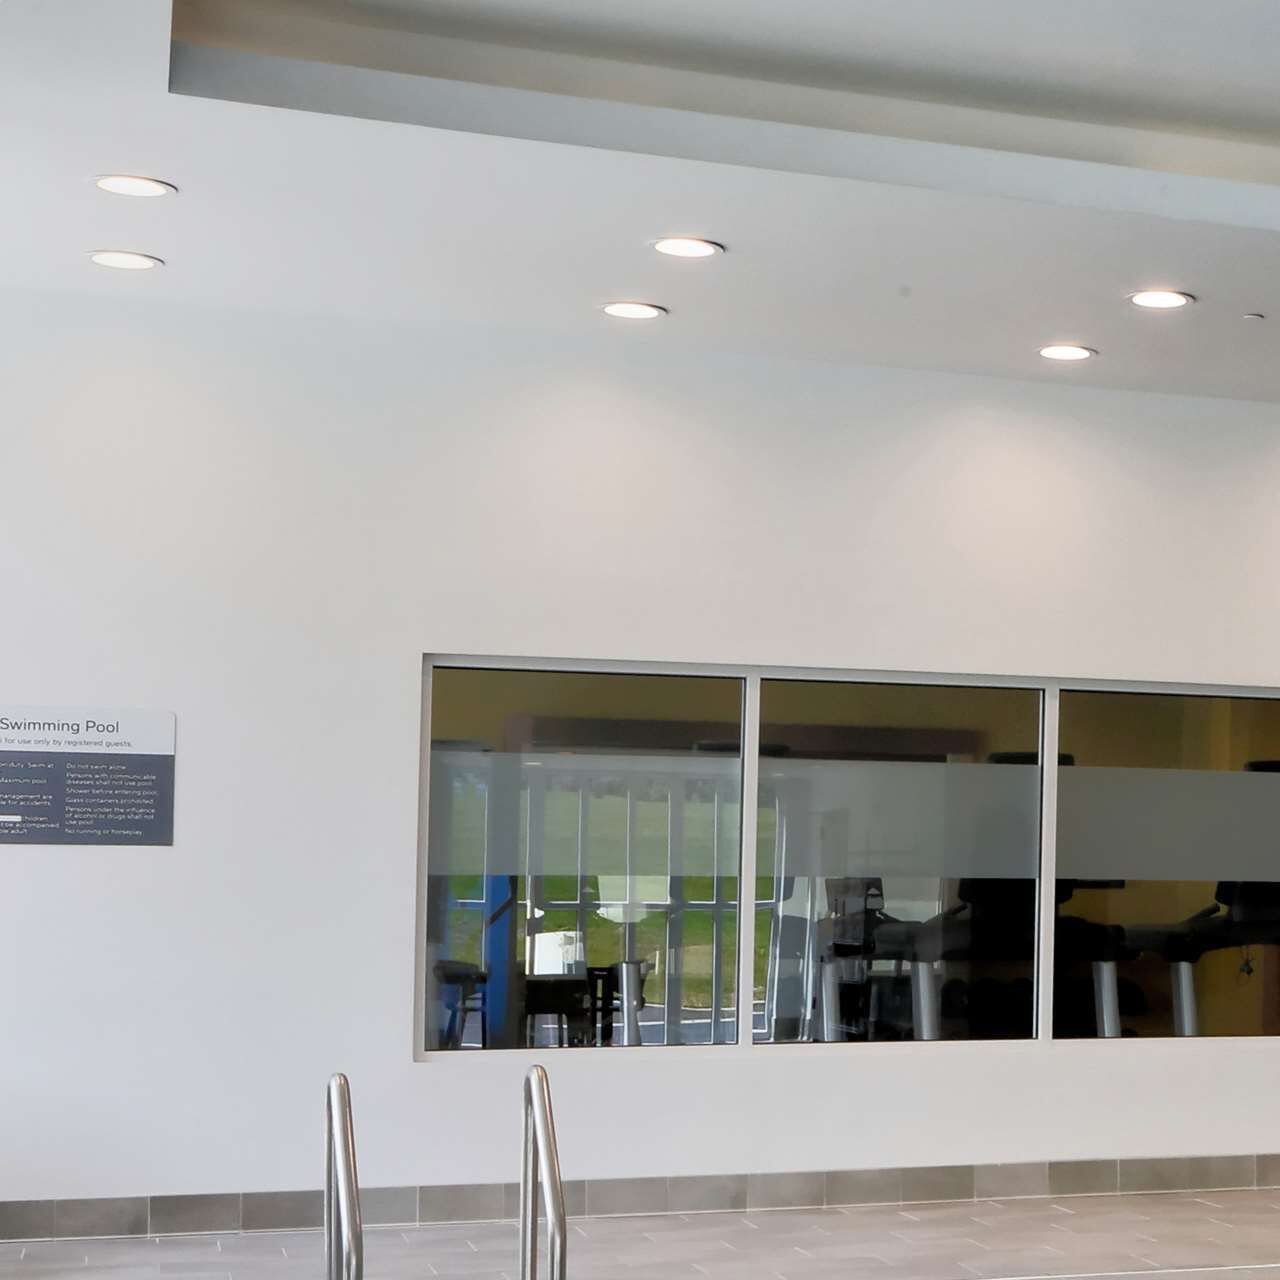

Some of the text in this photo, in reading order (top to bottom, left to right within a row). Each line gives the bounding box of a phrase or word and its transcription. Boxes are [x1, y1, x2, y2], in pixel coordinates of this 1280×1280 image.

[0, 717, 119, 735] Swimming Pool
[34, 738, 50, 747] only
[52, 739, 62, 747] by
[64, 739, 103, 748] registered
